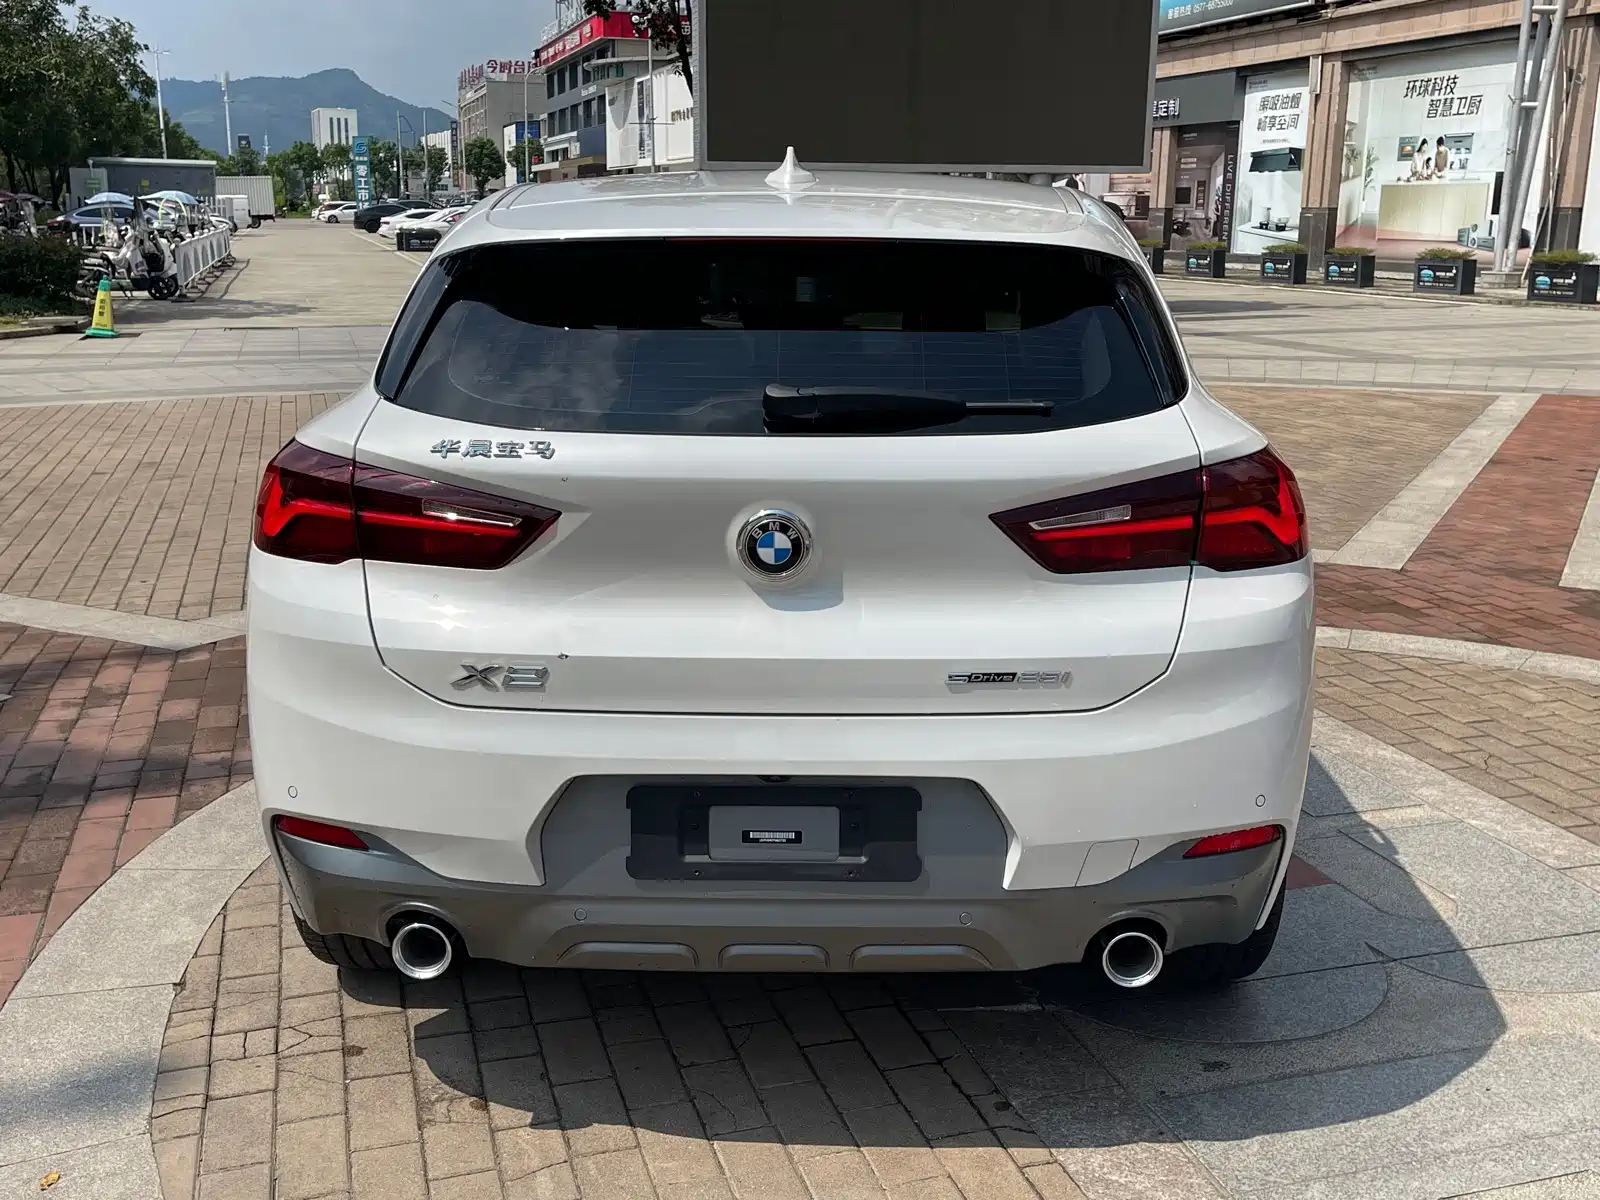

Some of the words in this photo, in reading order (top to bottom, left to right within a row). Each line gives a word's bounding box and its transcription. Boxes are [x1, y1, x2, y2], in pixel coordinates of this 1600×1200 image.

[1403, 74, 1459, 99] 环球科技
[1426, 94, 1483, 118] 智慧卫厨
[1257, 114, 1300, 132] 畅享空间
[1225, 154, 1234, 180] LIVE
[430, 438, 556, 459] 华晨宝马
[752, 521, 799, 540] BMW
[449, 664, 550, 689] X2
